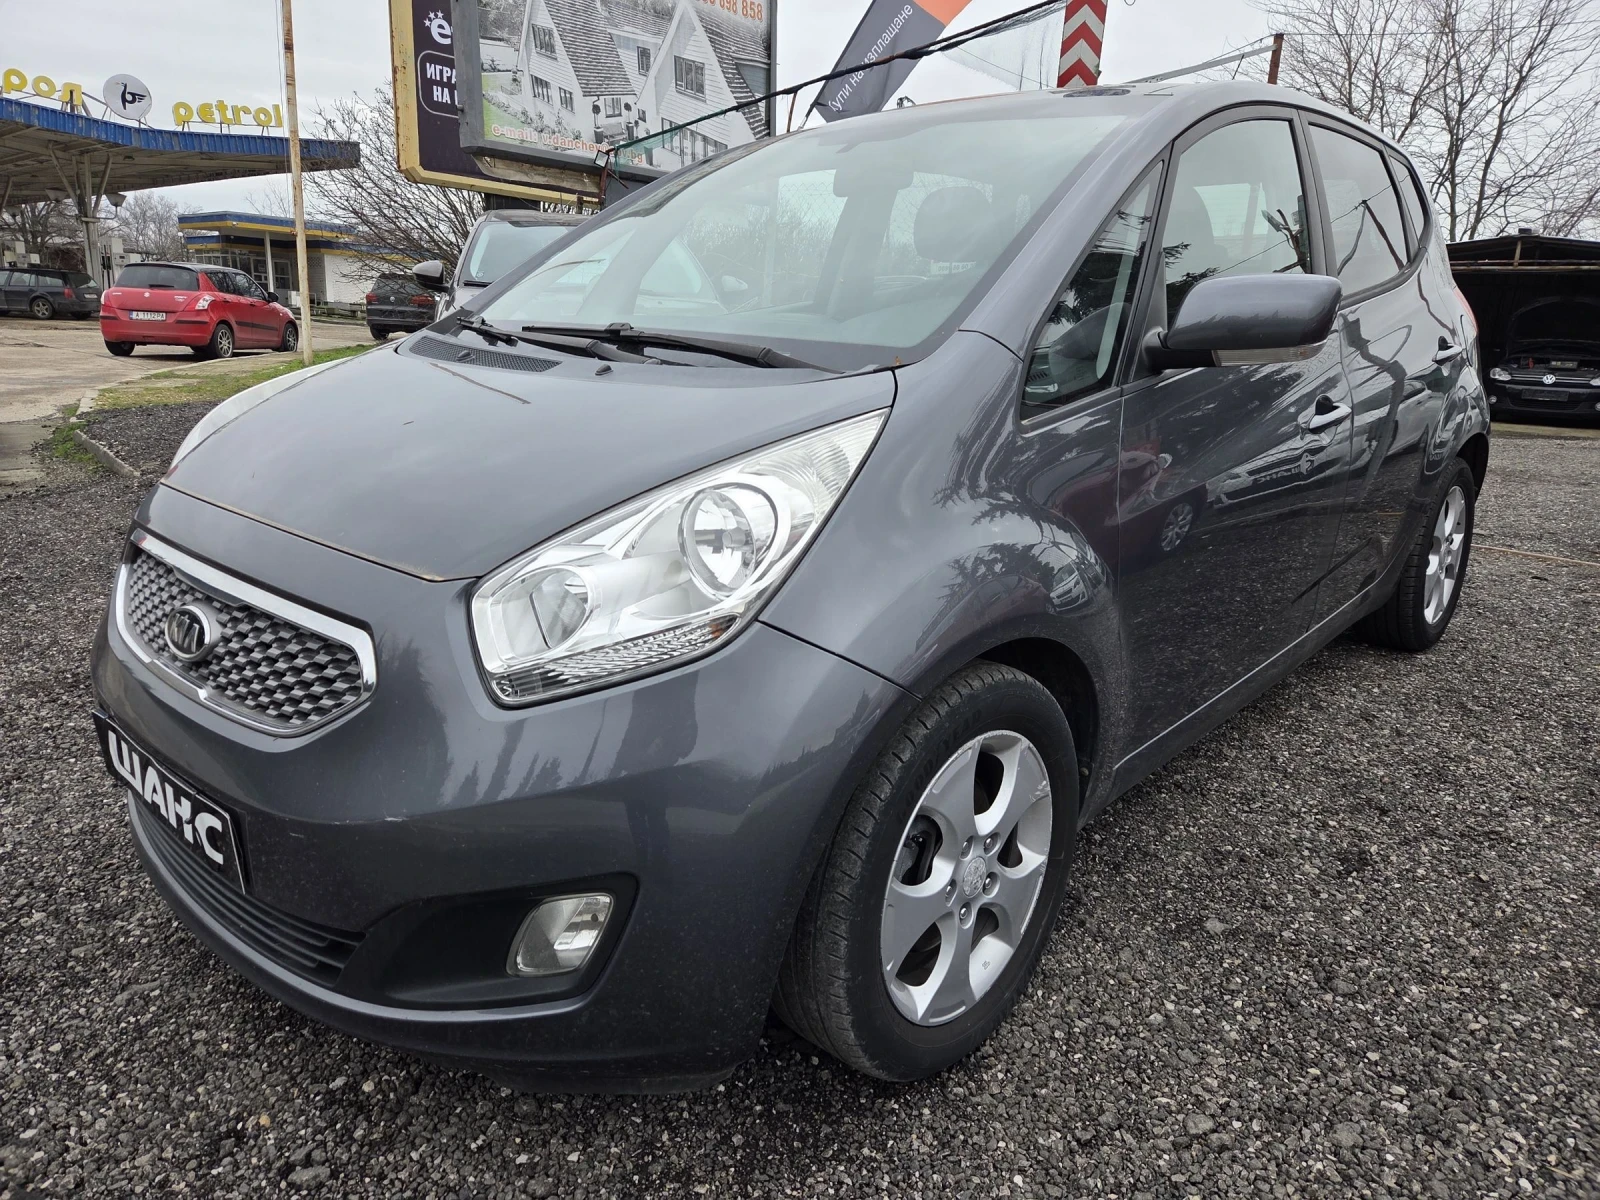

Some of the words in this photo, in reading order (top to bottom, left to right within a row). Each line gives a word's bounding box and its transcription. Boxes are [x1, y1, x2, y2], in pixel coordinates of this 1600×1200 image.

[741, 0, 763, 20] 858
[433, 85, 451, 105] НА
[172, 99, 283, 127] petrol
[492, 125, 537, 143] e-mail:
[108, 730, 225, 866] ШАНС
